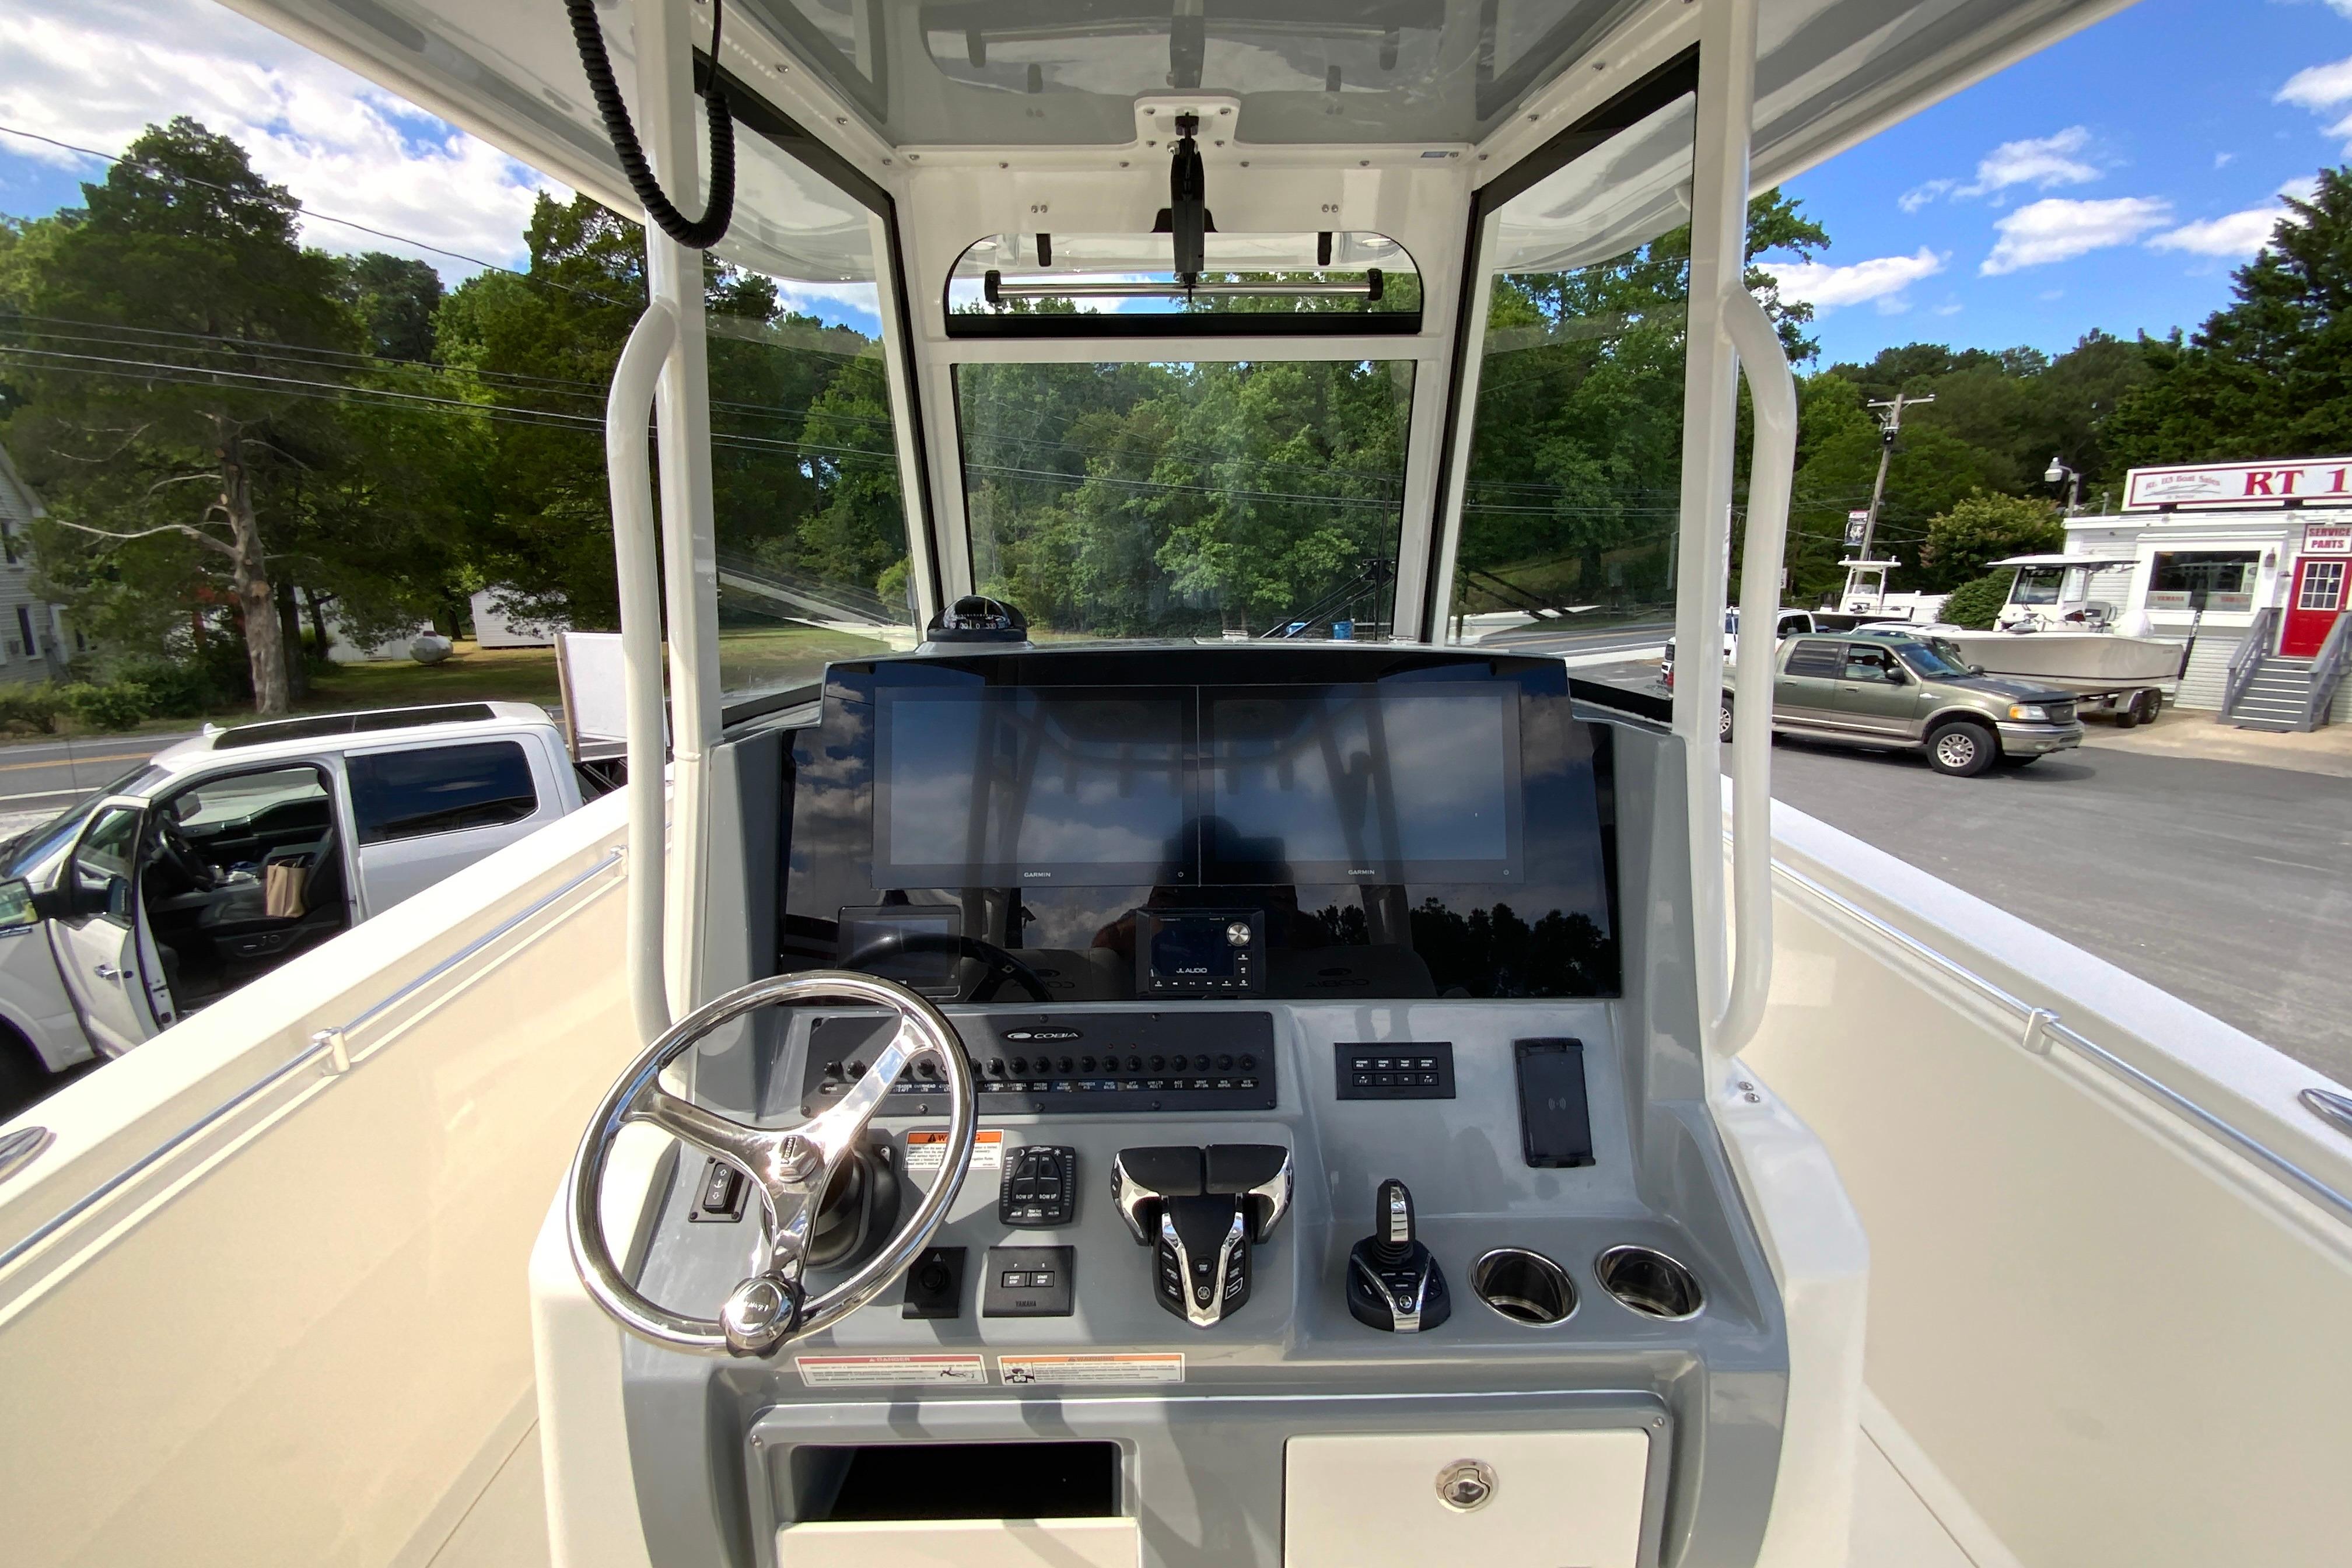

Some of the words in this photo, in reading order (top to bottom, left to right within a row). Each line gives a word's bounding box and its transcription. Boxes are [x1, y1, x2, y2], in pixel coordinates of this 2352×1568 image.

[2242, 470, 2305, 496] RT
[2308, 527, 2351, 537] SERVICE
[2311, 540, 2345, 549] PARTS
